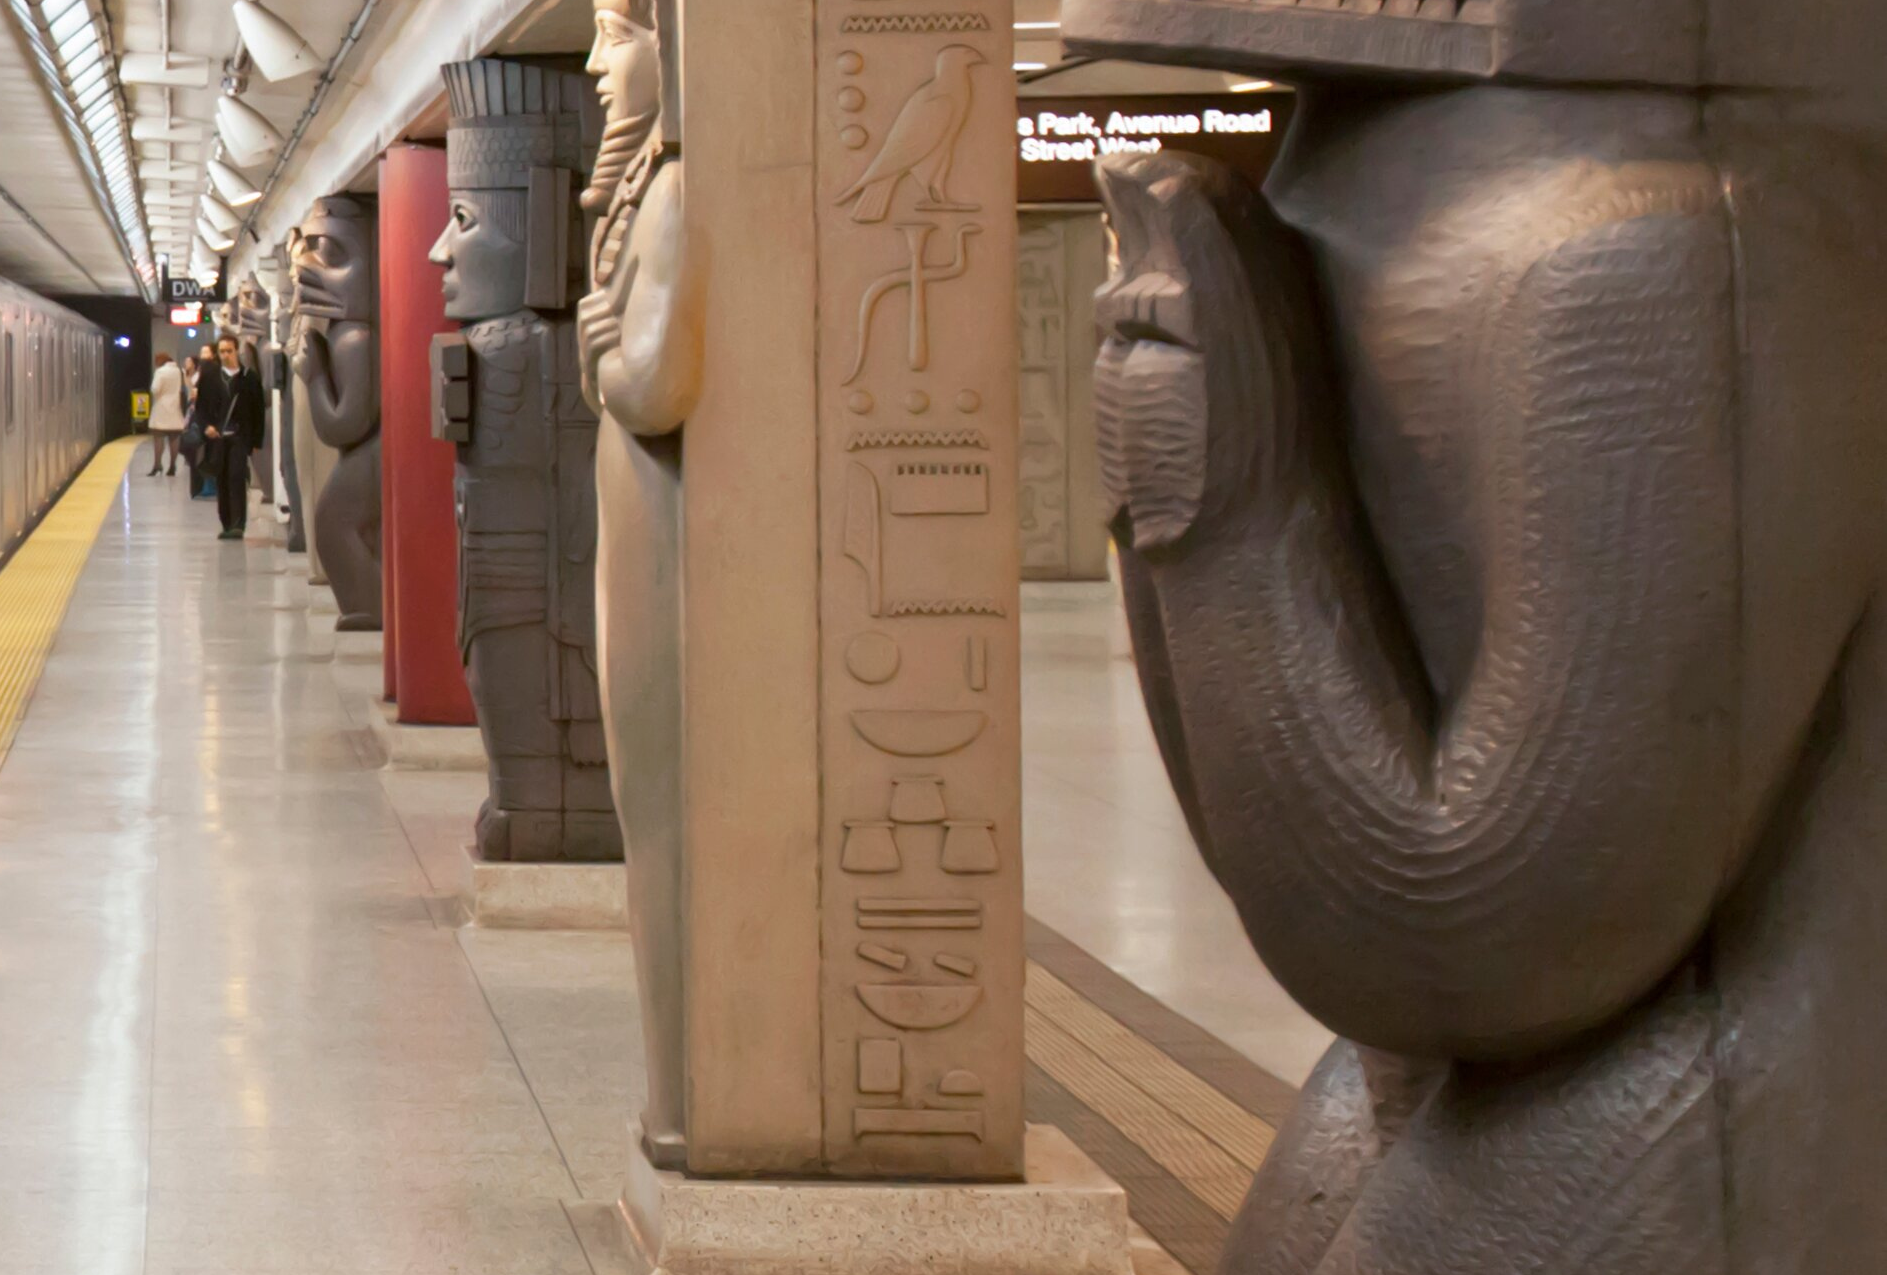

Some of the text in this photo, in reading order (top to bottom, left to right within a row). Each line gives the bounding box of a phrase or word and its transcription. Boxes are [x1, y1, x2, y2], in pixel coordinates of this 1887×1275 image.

[1038, 112, 1102, 138] Park,
[1105, 111, 1201, 134] Avenue
[1203, 109, 1272, 133] Road
[1020, 138, 1096, 162] Street
